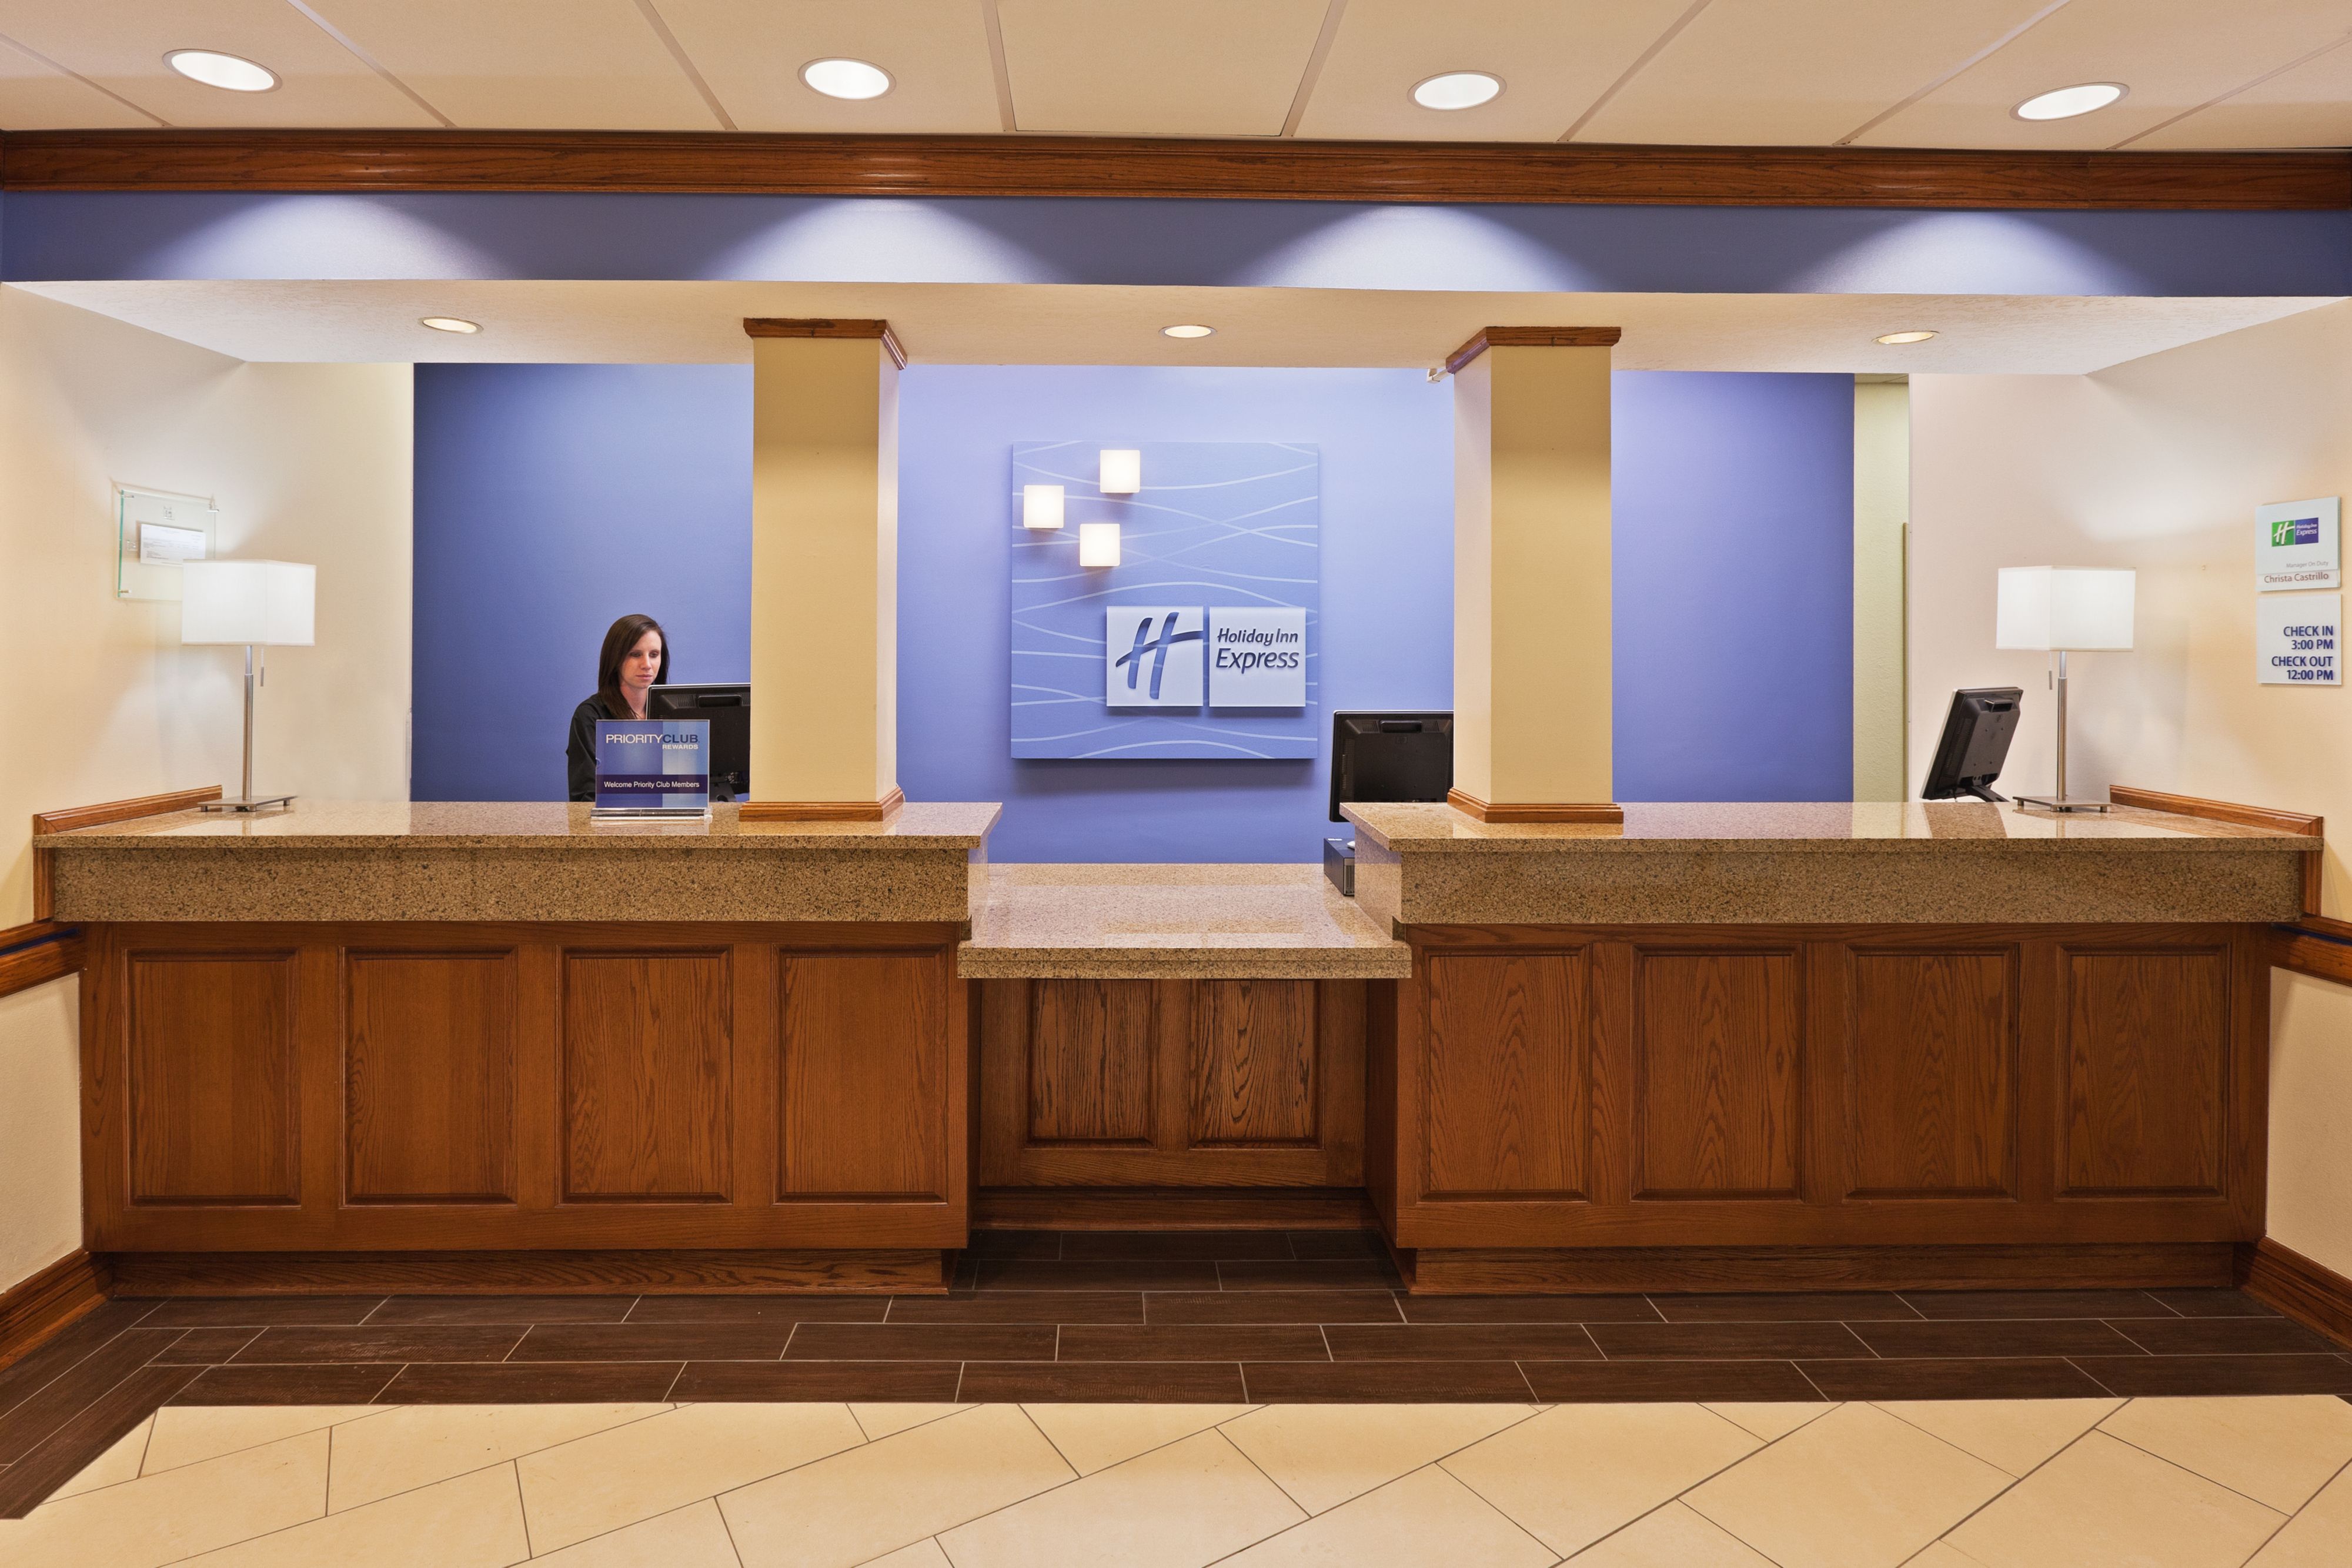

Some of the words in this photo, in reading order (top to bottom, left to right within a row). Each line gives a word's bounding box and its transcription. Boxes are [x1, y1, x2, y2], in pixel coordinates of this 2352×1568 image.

[2264, 574, 2292, 583] Christa
[2294, 571, 2329, 581] Castrillo
[1217, 628, 1273, 646] Holiday
[1275, 628, 1298, 643] Inn
[2283, 626, 2319, 637] CHECK
[2322, 626, 2333, 636] IN
[2291, 640, 2314, 650] 3:00
[2317, 638, 2333, 650] PM
[1215, 647, 1299, 674] Express
[2271, 656, 2307, 667] CHECK
[2309, 656, 2333, 667] OUT
[2287, 670, 2314, 680] 12:00
[2317, 670, 2333, 680] PM
